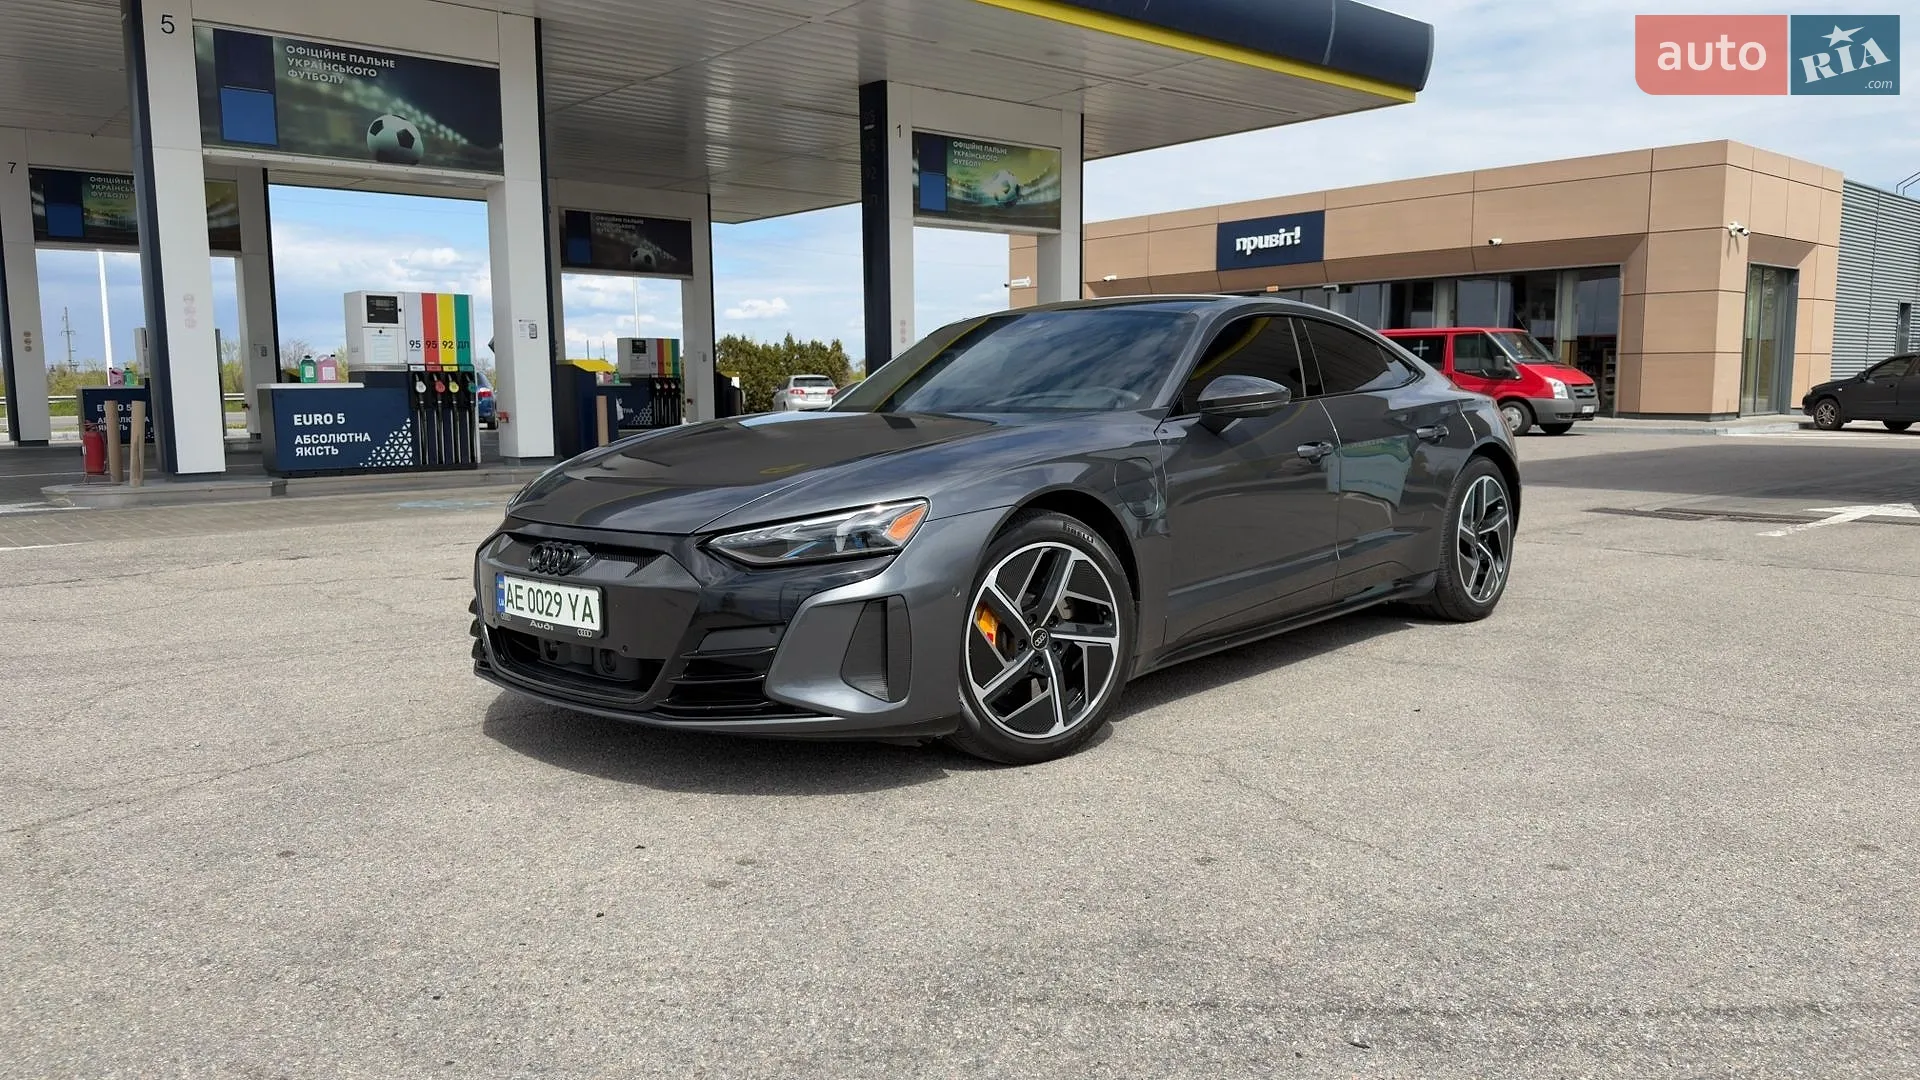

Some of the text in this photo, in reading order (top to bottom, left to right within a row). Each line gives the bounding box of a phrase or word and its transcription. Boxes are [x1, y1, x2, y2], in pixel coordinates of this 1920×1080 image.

[161, 14, 175, 34] 5
[286, 45, 396, 69] ОФІЦІЙНЕ ПАЛЬНЕ
[287, 57, 378, 77] УКРАЇНСЬКОГО
[287, 69, 345, 84] ФУТБОЛУ
[896, 124, 902, 138] 1
[8, 161, 16, 174] 7
[1235, 226, 1301, 256] привіт!
[409, 340, 421, 349] 95
[425, 340, 438, 349] 95
[442, 340, 454, 349] 92
[293, 413, 346, 426] EURO 5
[294, 432, 372, 445] АБСОЛЮТНА
[295, 446, 339, 457] ЯКІСТЬ
[506, 583, 595, 624] AE 0029 YA
[529, 620, 554, 631] Audi
